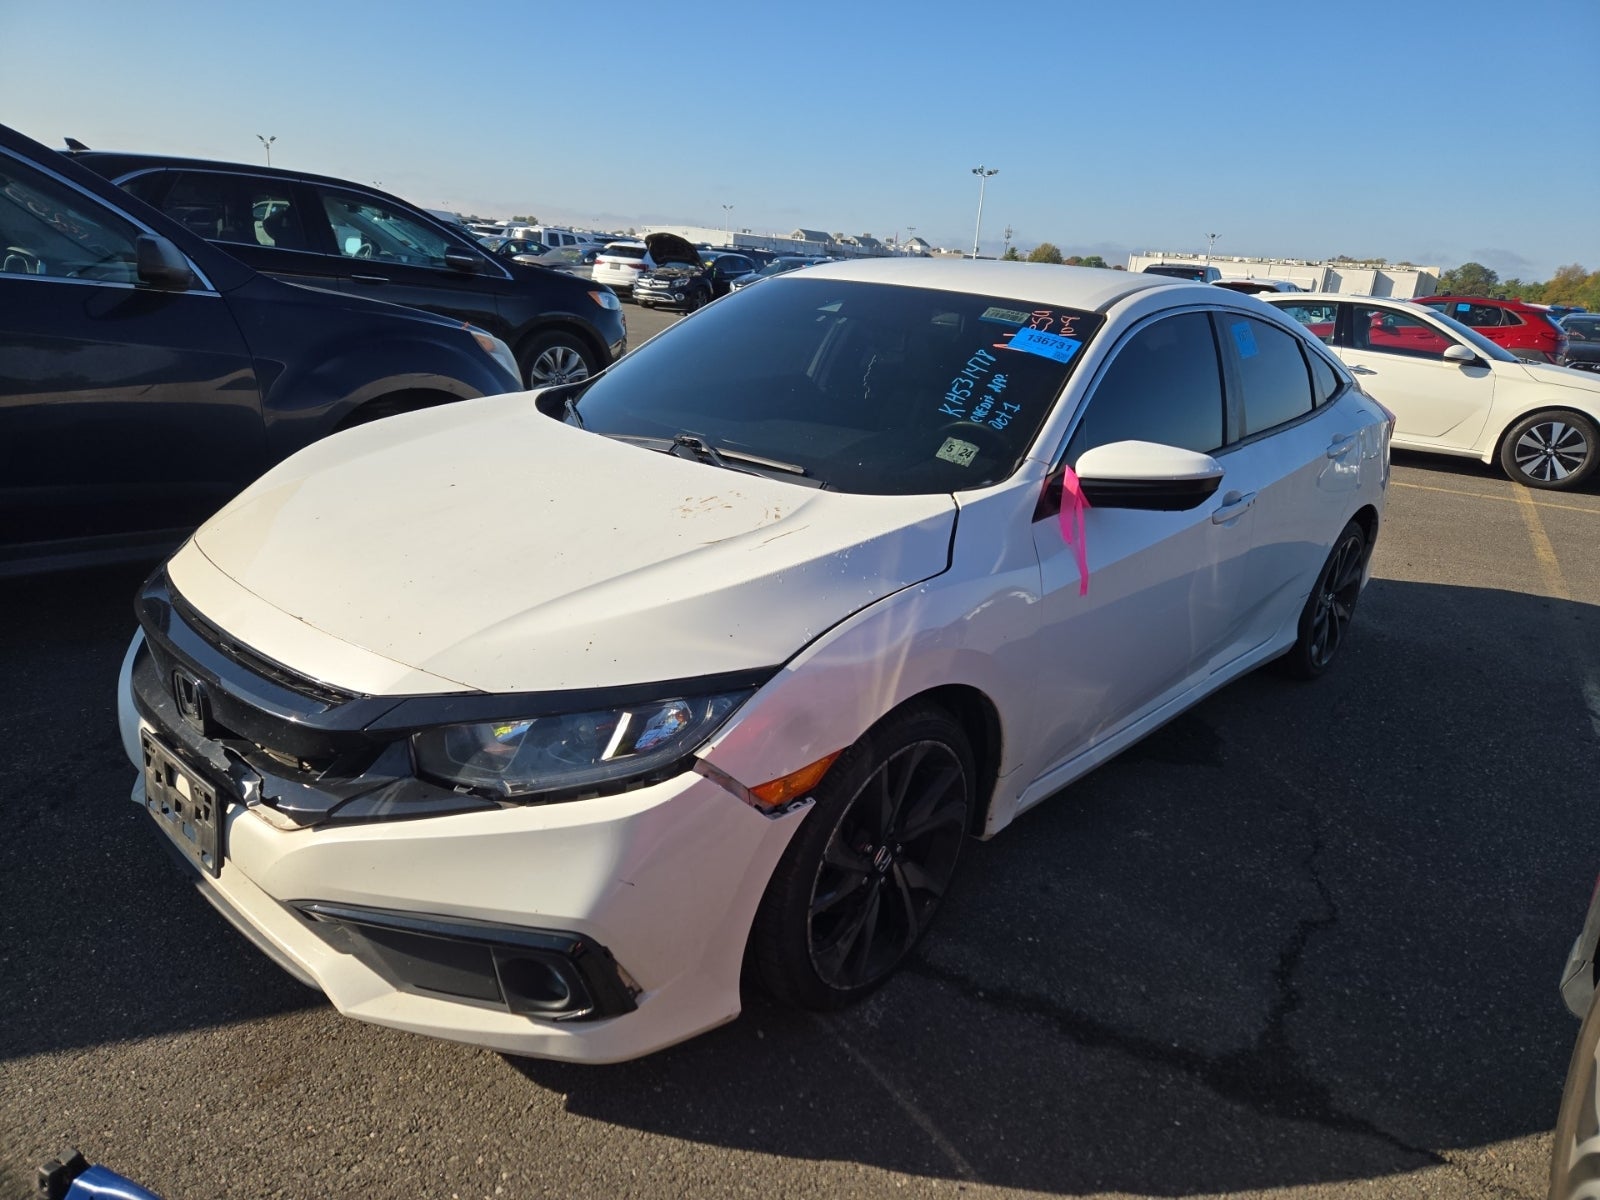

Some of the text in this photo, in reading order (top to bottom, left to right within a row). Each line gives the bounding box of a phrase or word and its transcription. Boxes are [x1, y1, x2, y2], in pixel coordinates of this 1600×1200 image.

[1027, 334, 1073, 352] 136731
[1003, 401, 1021, 413] 1
[946, 444, 974, 459] 5 24
